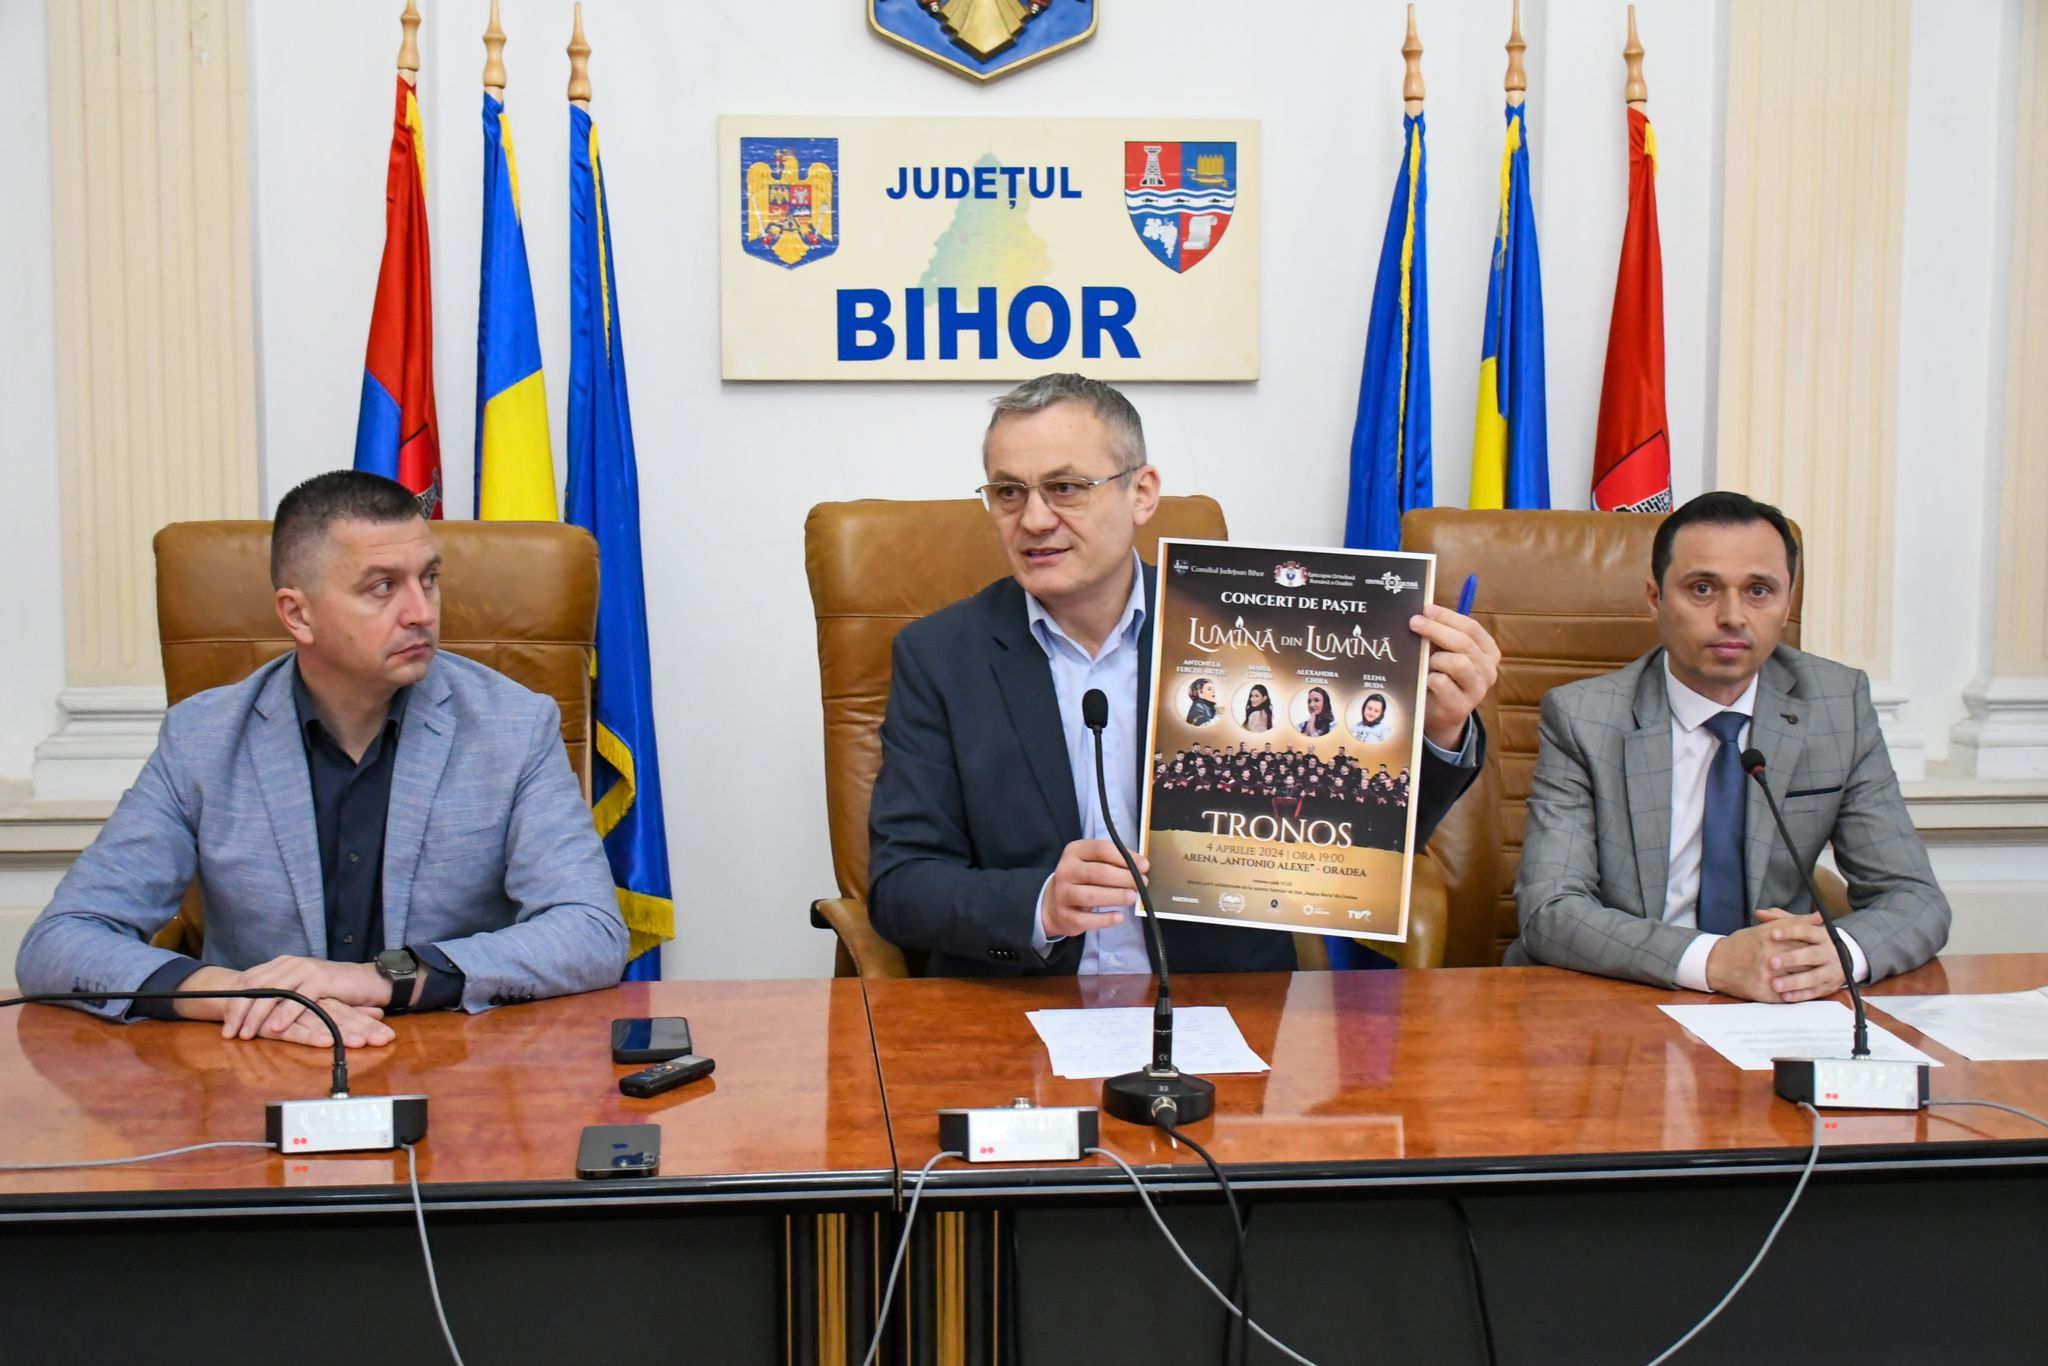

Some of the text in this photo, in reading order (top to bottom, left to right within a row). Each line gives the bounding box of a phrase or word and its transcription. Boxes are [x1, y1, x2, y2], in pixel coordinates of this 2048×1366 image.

[886, 166, 1082, 209] JUDEȚUL
[837, 285, 1142, 361] BIHOR
[1190, 565, 1218, 574] Consiliul
[1248, 569, 1265, 577] Bihor
[1220, 591, 1367, 614] CONCERT DE PAȘTE
[1188, 616, 1398, 662] LUMINĂ DIN LUMINĂ
[1296, 669, 1339, 678] ALEXANDRA
[1363, 674, 1387, 682] ELENA
[1363, 681, 1385, 689] BUDA
[1201, 810, 1353, 849] TRONOS
[1206, 842, 1213, 851] 4
[1215, 844, 1256, 856] APRILIE
[1259, 847, 1284, 858] 2024
[1292, 851, 1316, 861] ORA
[1319, 852, 1345, 863] 19:00
[1182, 853, 1218, 864] ARENA
[1322, 865, 1367, 877] ORADEA
